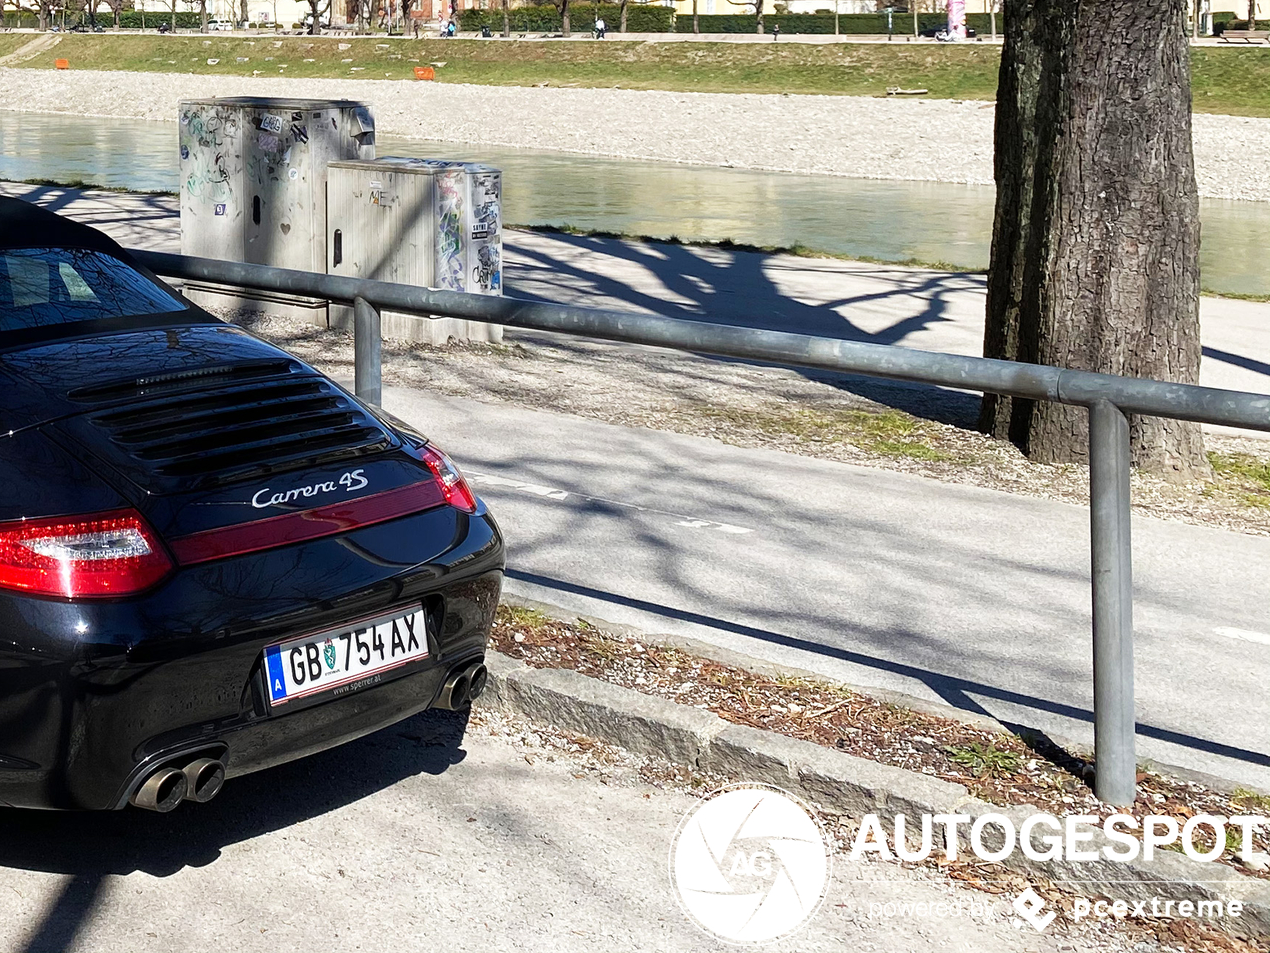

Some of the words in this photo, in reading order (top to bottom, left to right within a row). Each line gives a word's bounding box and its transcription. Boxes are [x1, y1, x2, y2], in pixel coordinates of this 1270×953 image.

[251, 481, 337, 508] Carrera
[339, 469, 369, 491] 4S
[290, 642, 322, 686] GB
[339, 625, 385, 671] 754
[391, 613, 420, 658] AX
[332, 674, 382, 695] www.sperrer.at
